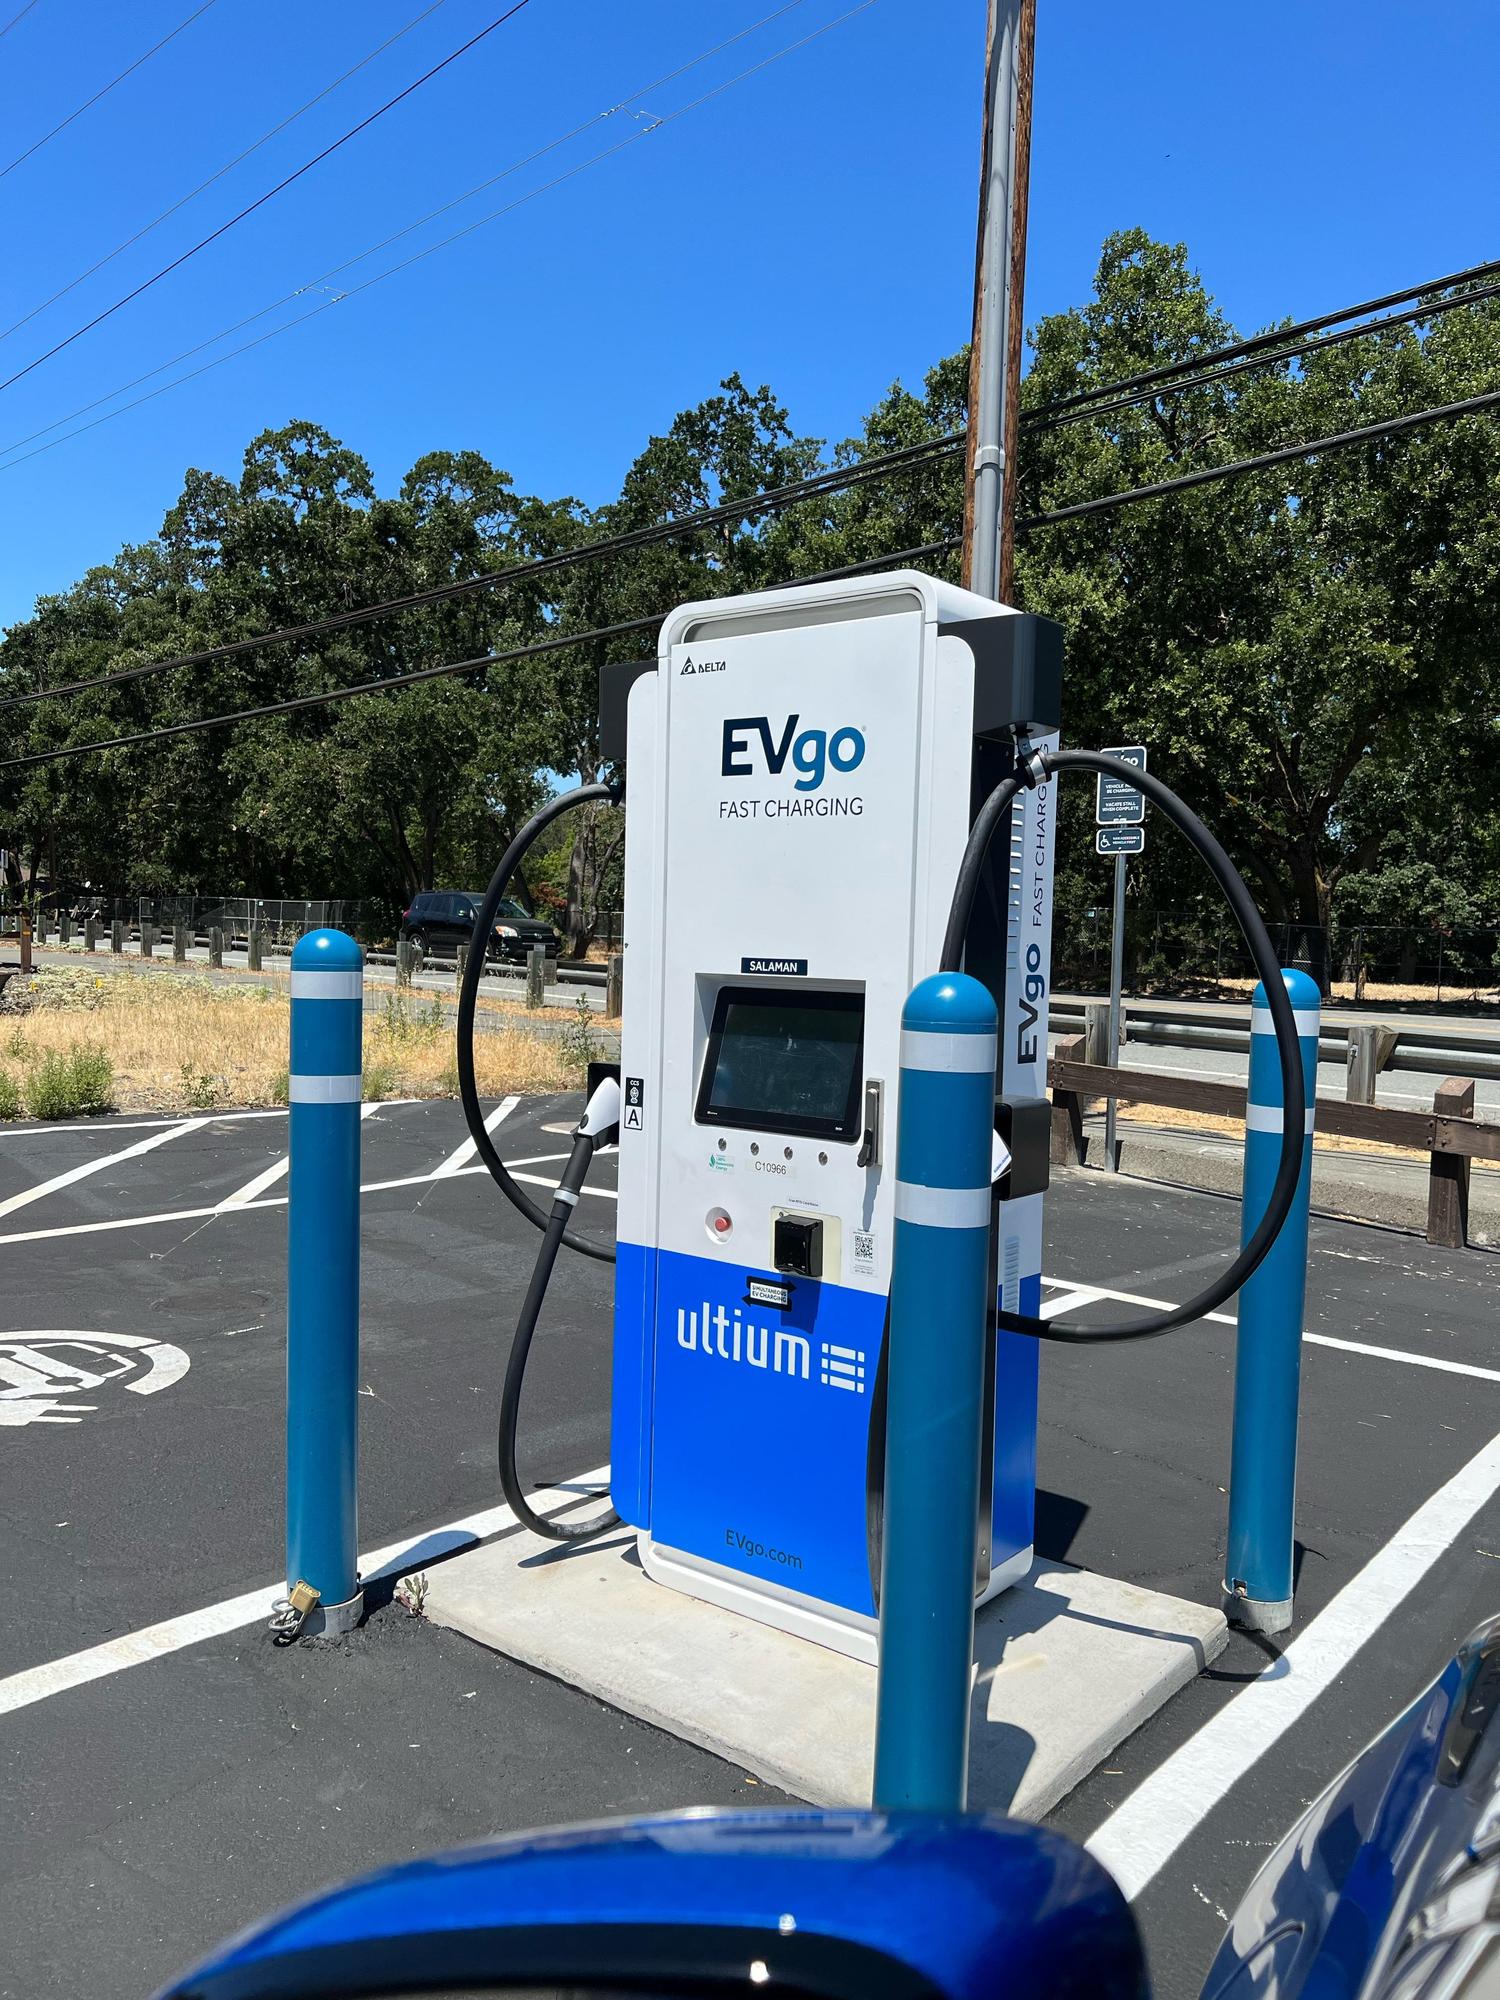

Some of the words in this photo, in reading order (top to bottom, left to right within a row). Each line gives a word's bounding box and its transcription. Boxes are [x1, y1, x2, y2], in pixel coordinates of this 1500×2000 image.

[698, 661, 726, 673] DELTA
[721, 714, 866, 792] EVgo
[719, 801, 760, 818] FAST
[764, 797, 863, 818] CHARGING
[749, 960, 798, 973] SALAMAN
[1018, 943, 1045, 1065] EVgo
[1033, 872, 1044, 926] FAST
[629, 1079, 640, 1087] CCS
[627, 1108, 639, 1126] A
[754, 1160, 787, 1175] C10966
[760, 1292, 787, 1303] CHARGING
[677, 1301, 810, 1380] ultium
[725, 1528, 803, 1570] EVgo.com
